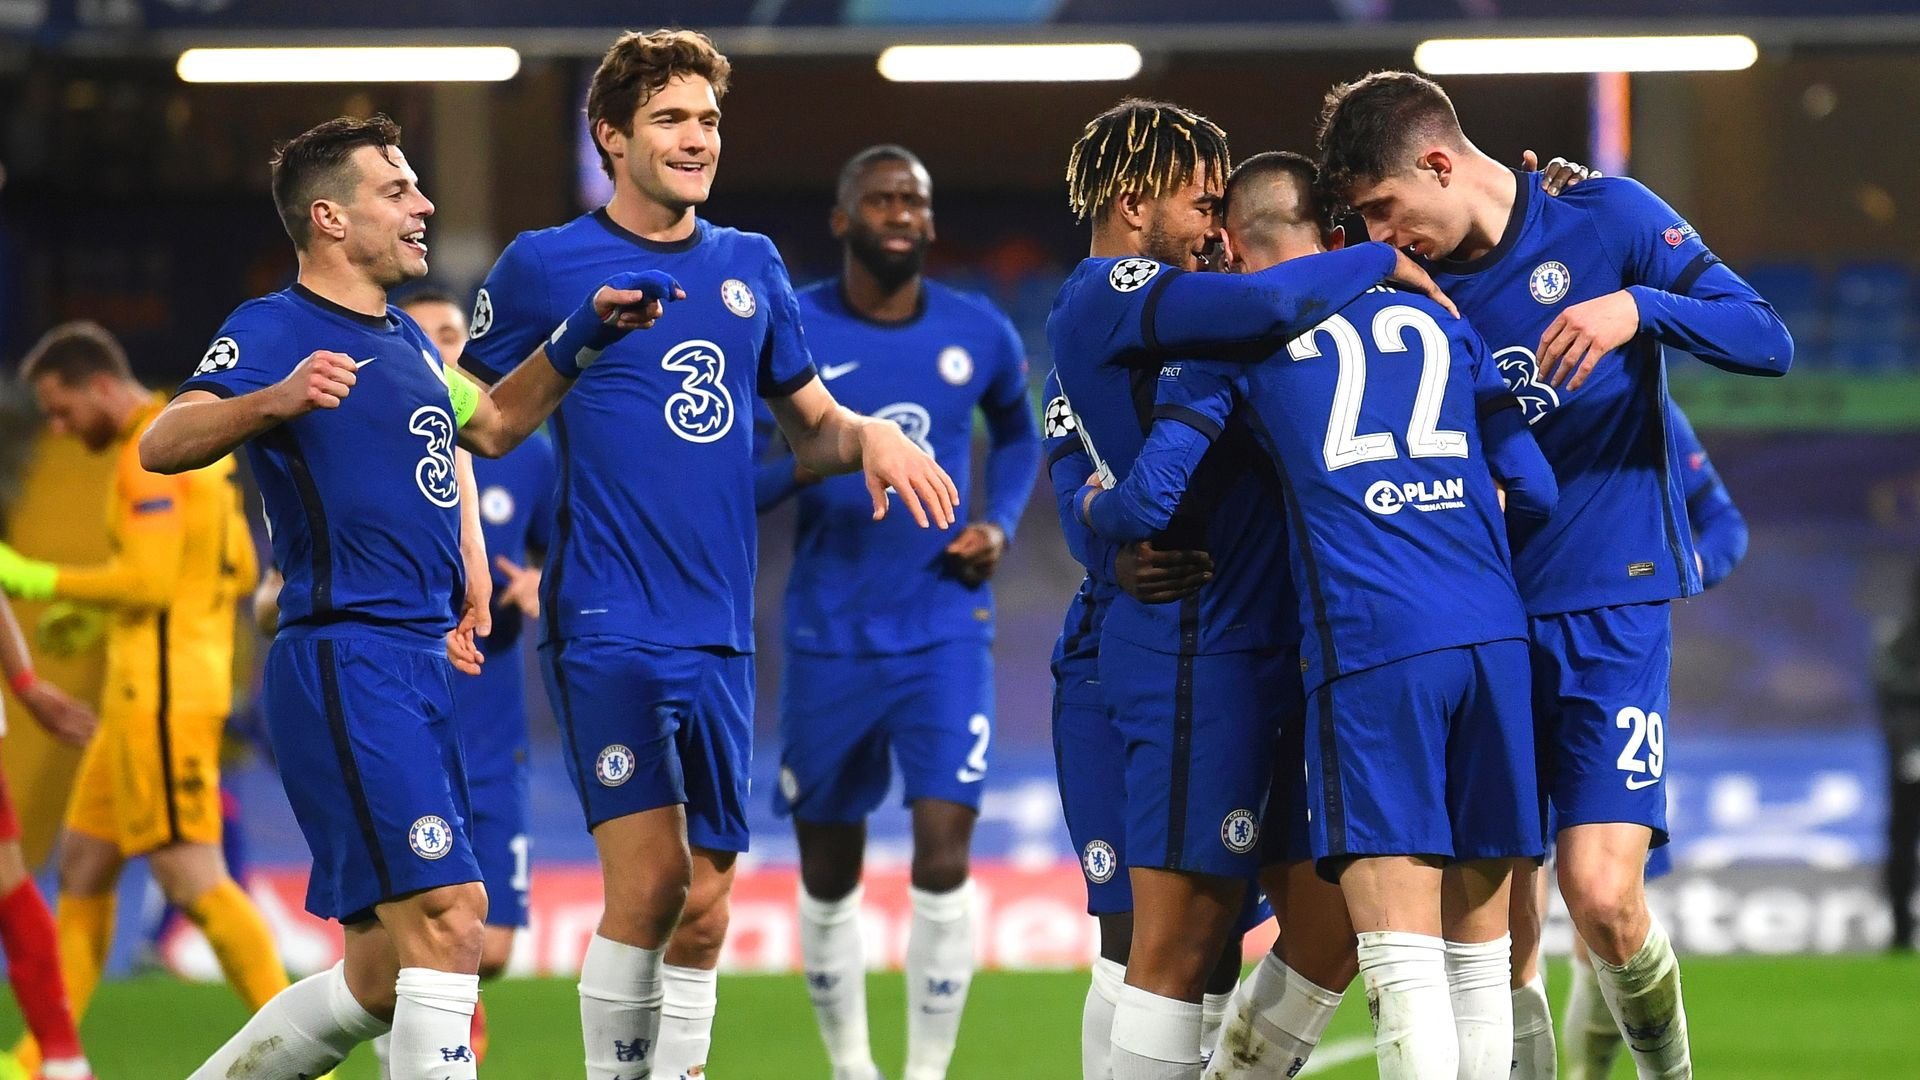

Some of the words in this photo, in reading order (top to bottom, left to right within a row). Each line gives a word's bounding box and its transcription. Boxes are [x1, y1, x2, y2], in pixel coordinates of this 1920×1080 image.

[1286, 304, 1468, 472] 22
[1403, 478, 1464, 502] PLAN
[967, 713, 991, 773] 2
[1616, 706, 1664, 778] 29
